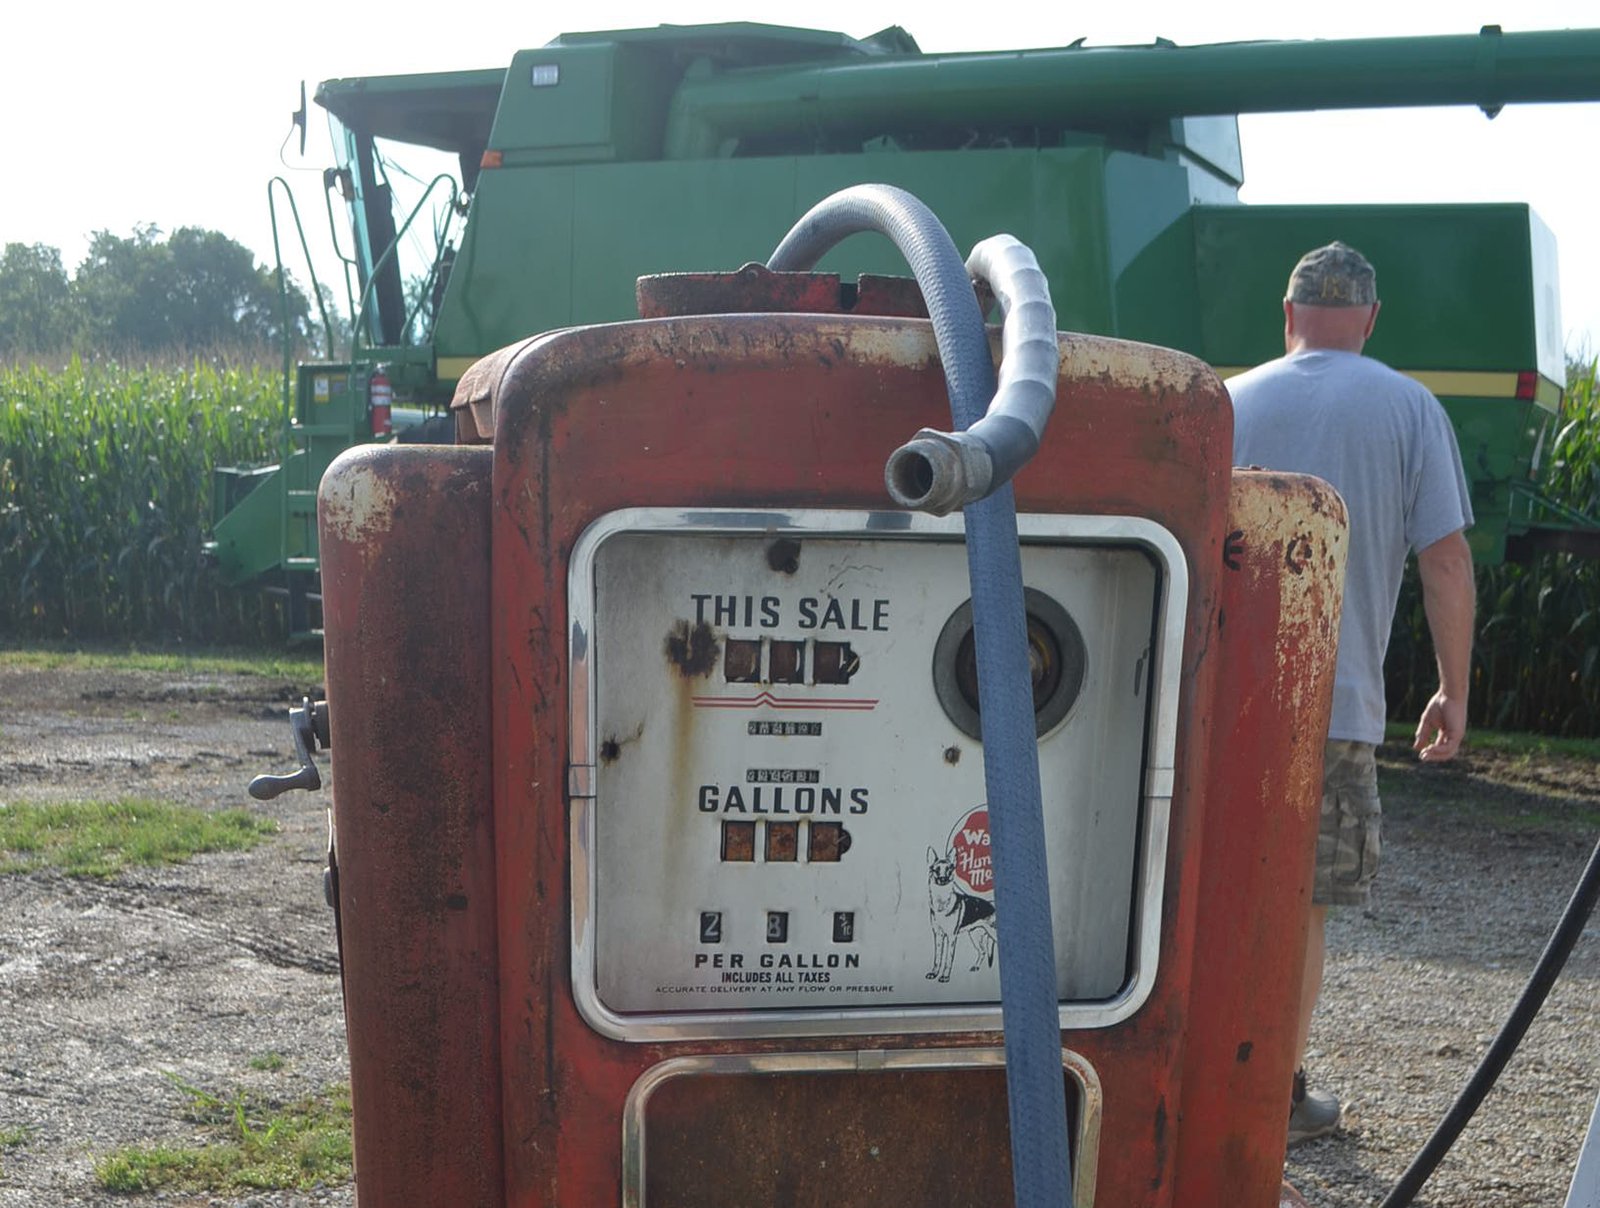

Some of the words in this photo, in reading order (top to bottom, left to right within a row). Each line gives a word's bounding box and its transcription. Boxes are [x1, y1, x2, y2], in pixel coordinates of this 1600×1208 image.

[691, 595, 780, 628] THIS
[798, 598, 890, 630] SALE
[699, 785, 869, 815] GALLONS
[962, 828, 991, 846] Wa
[968, 868, 994, 886] Me
[704, 913, 720, 937] 2
[694, 953, 744, 969] PER
[760, 953, 860, 968] GALLON
[721, 971, 772, 983] INCLUDES
[775, 971, 794, 983] ALL
[798, 971, 830, 983] TAXES
[655, 986, 706, 994] ACCURATE
[798, 985, 826, 993] FLOW
[829, 985, 843, 993] OR
[846, 985, 895, 993] PRESSURE
